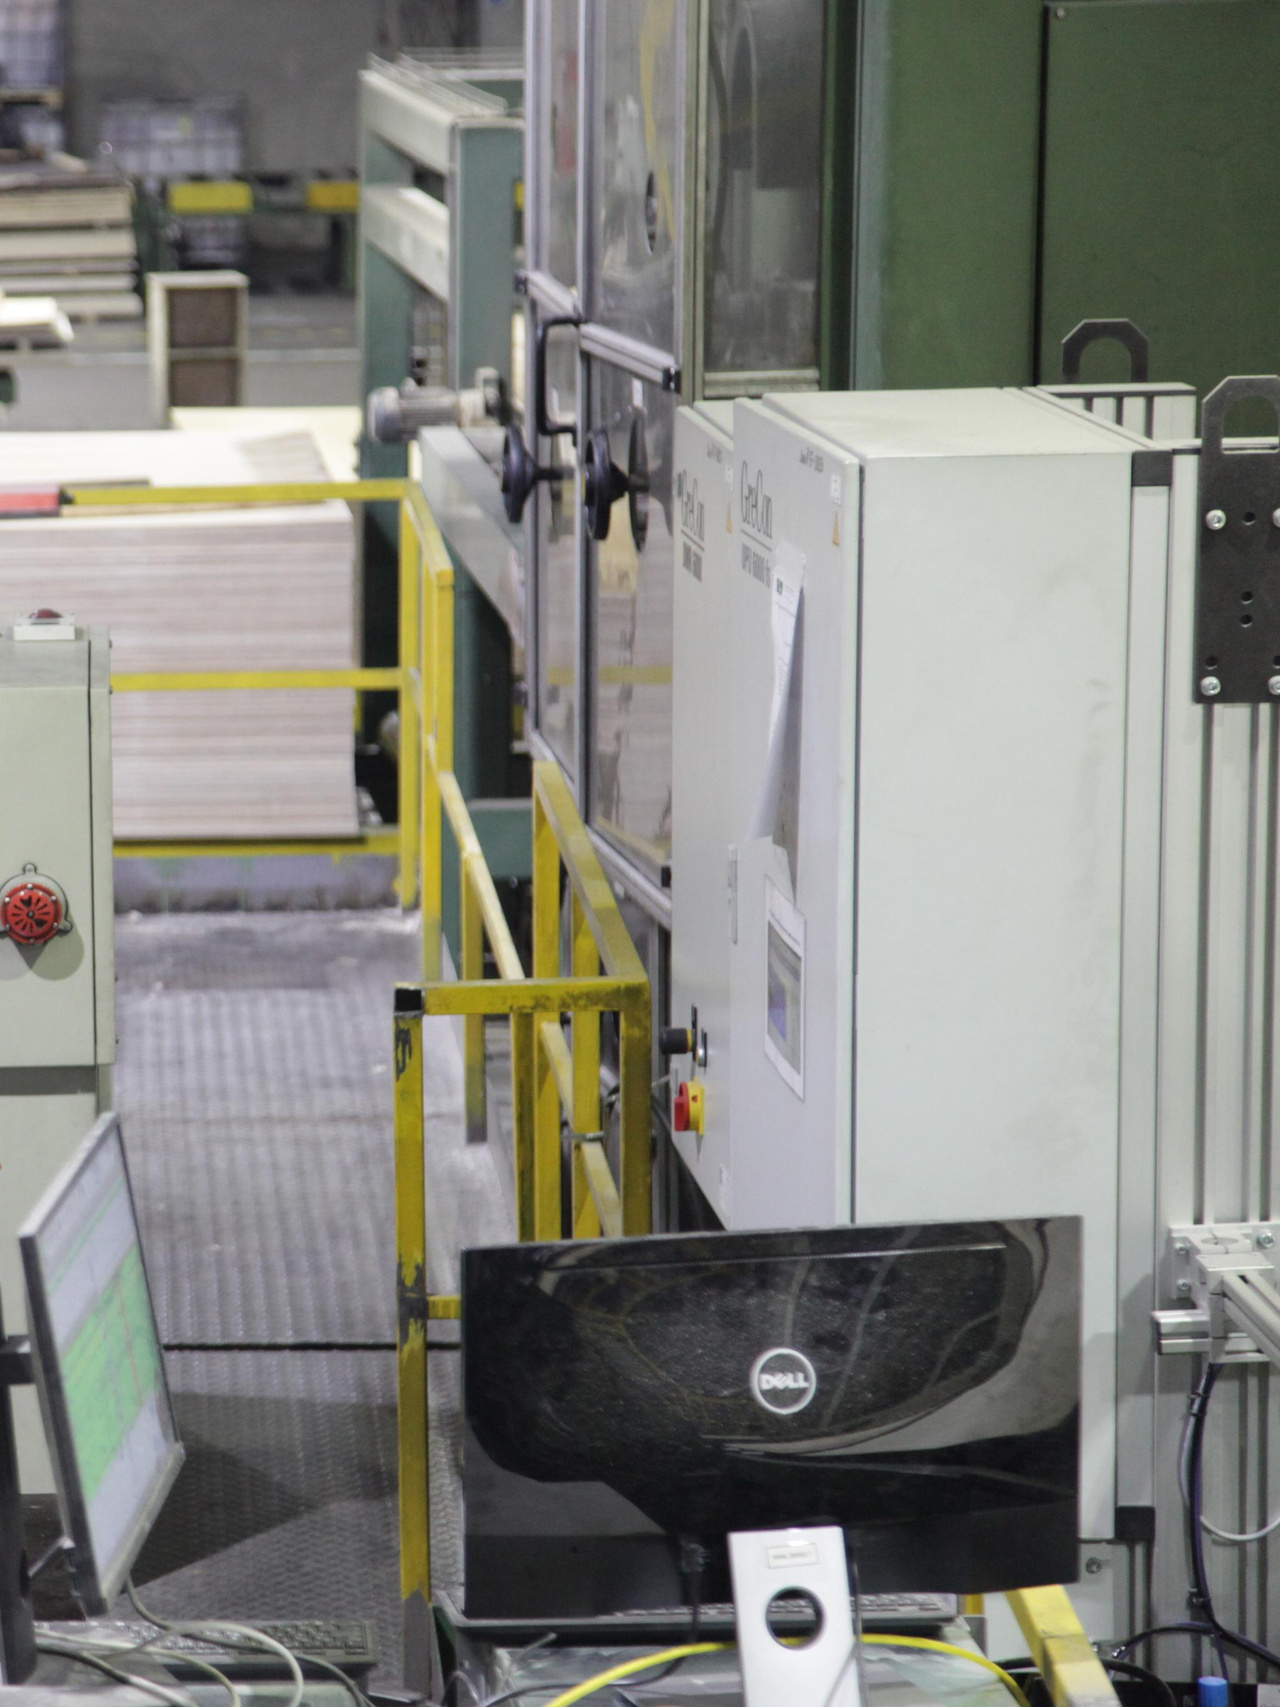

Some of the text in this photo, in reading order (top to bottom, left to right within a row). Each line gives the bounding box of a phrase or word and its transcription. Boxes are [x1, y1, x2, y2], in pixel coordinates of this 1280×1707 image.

[681, 469, 705, 542] GreCon
[740, 460, 773, 539] GreCon
[760, 1371, 810, 1391] DELL
